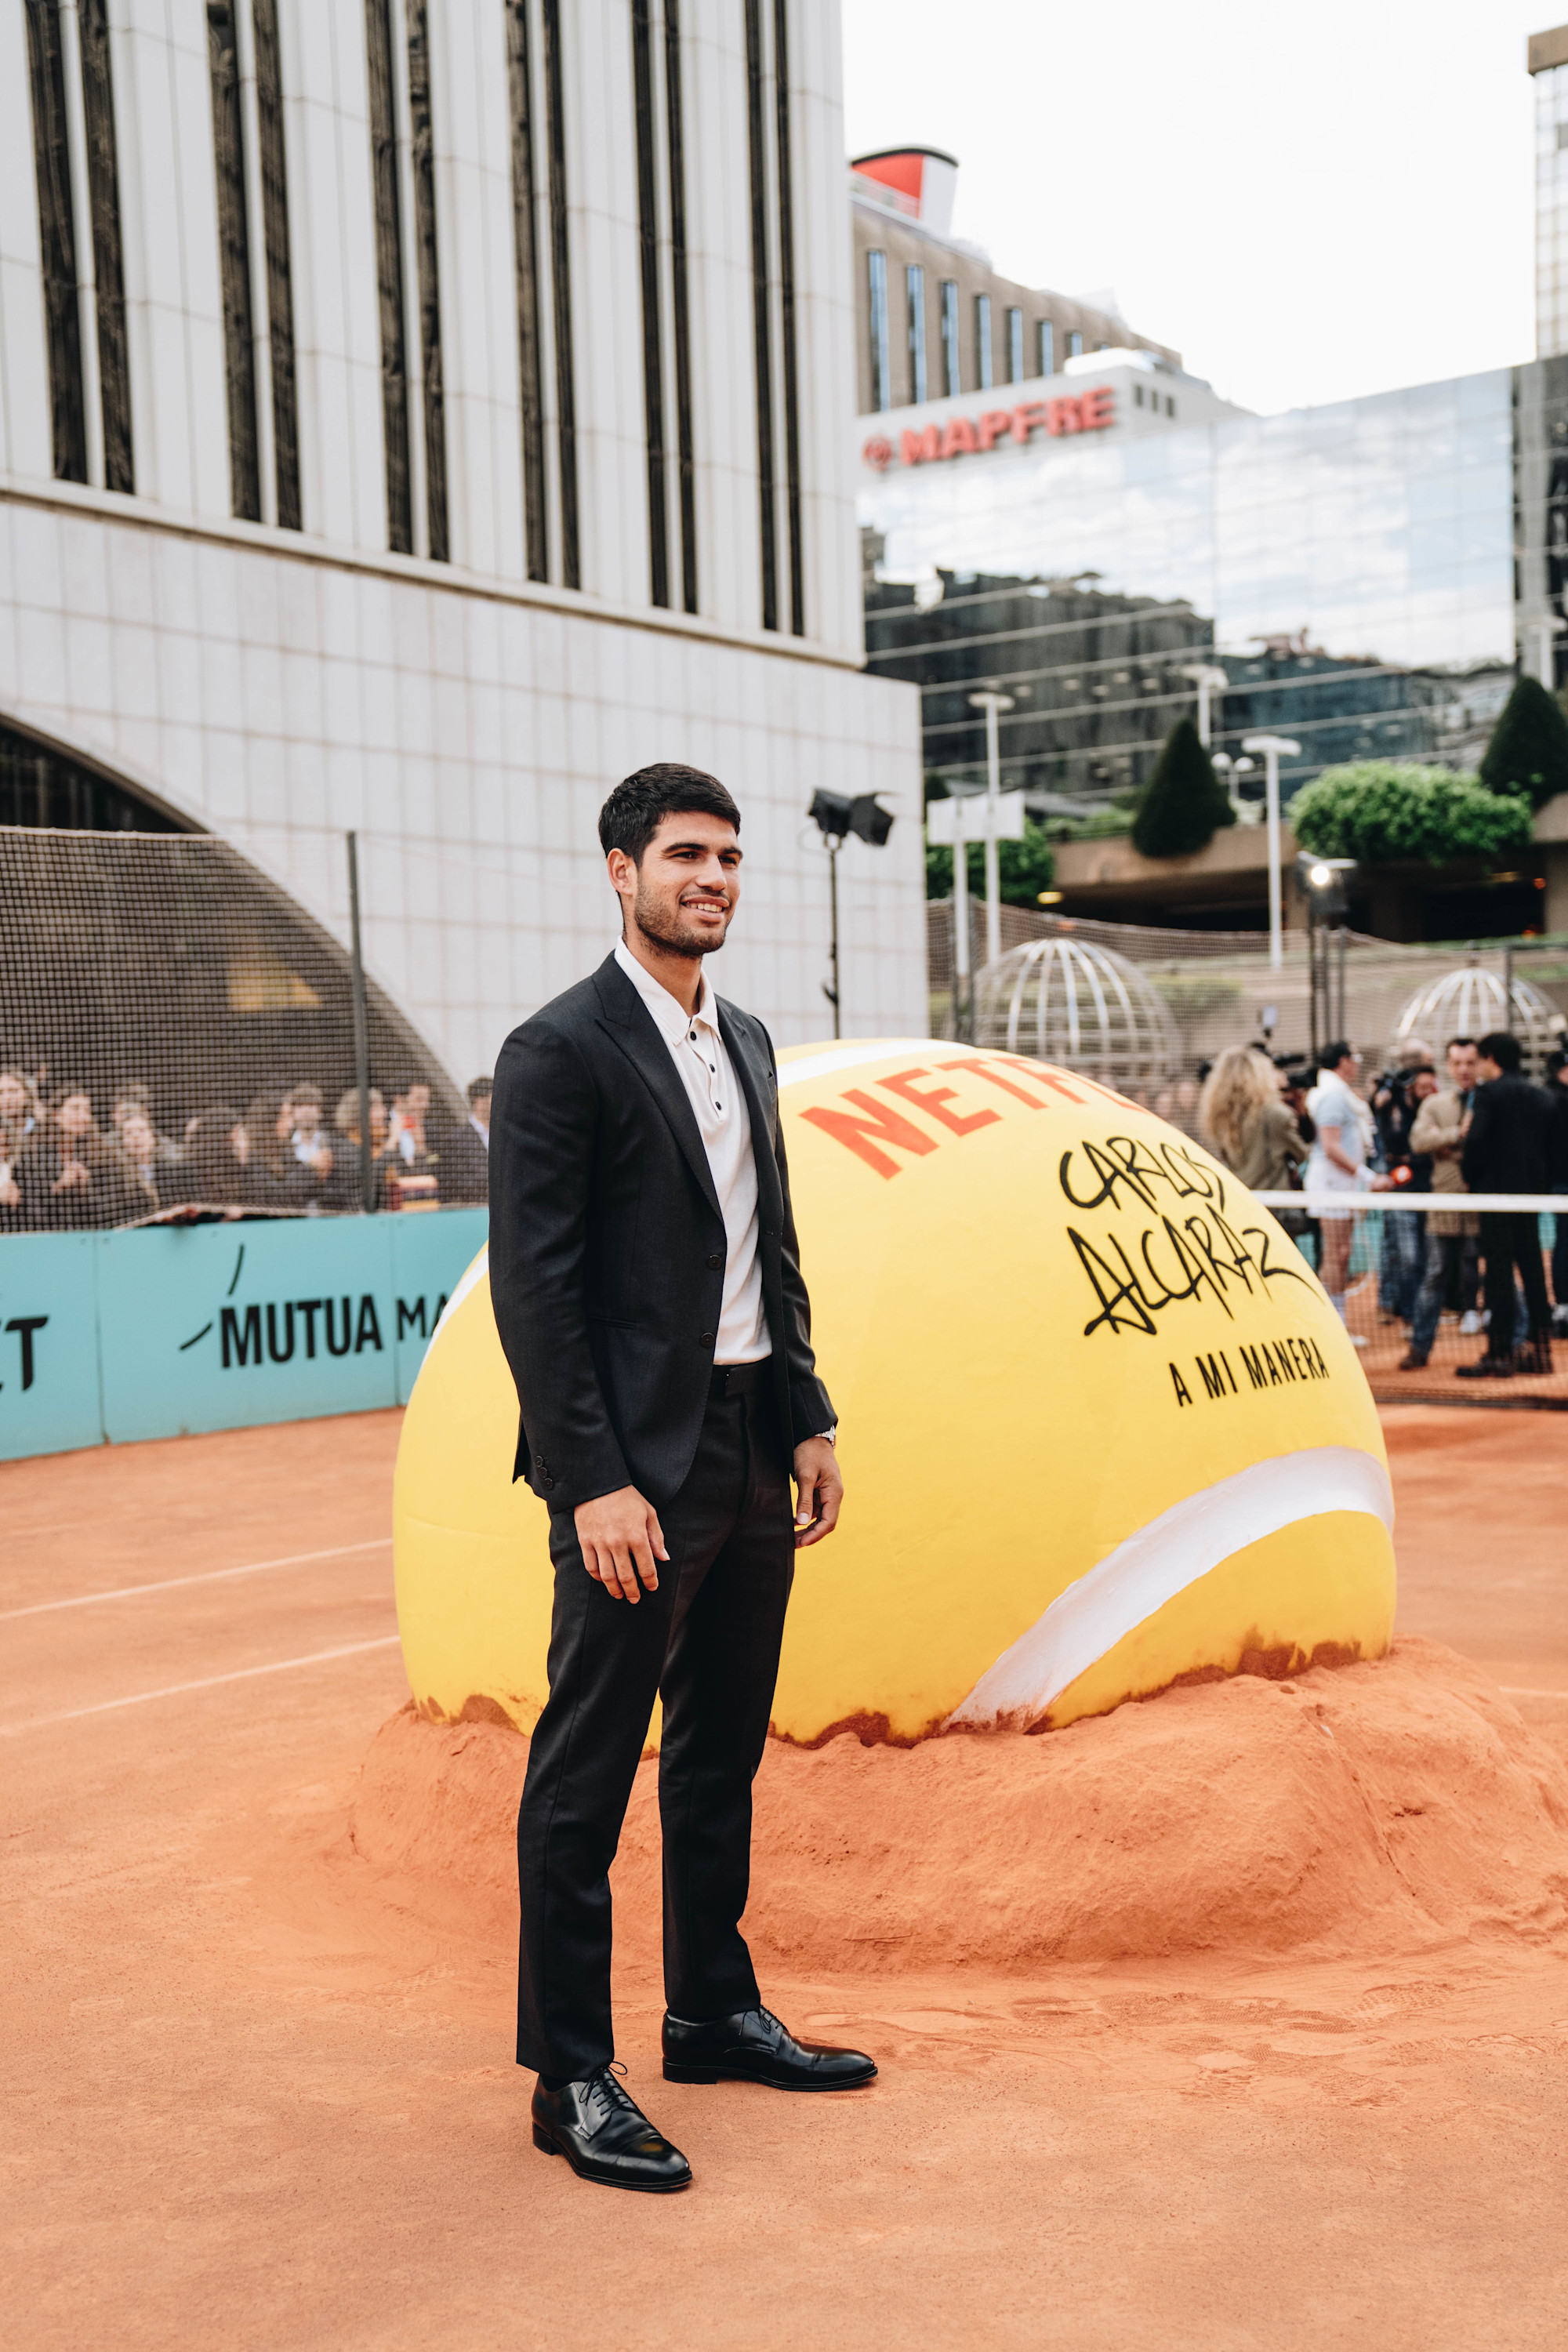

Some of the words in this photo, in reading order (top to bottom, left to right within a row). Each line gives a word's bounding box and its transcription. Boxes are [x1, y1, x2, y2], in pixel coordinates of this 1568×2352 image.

[900, 386, 1115, 466] MAPFRE
[1058, 1136, 1225, 1215] CARLOS
[1066, 1202, 1327, 1336] ALCARAZ
[220, 1294, 383, 1369] MUTUA
[1168, 1362, 1193, 1407] A
[1195, 1350, 1238, 1399] MI
[1239, 1338, 1330, 1389] MANERA
